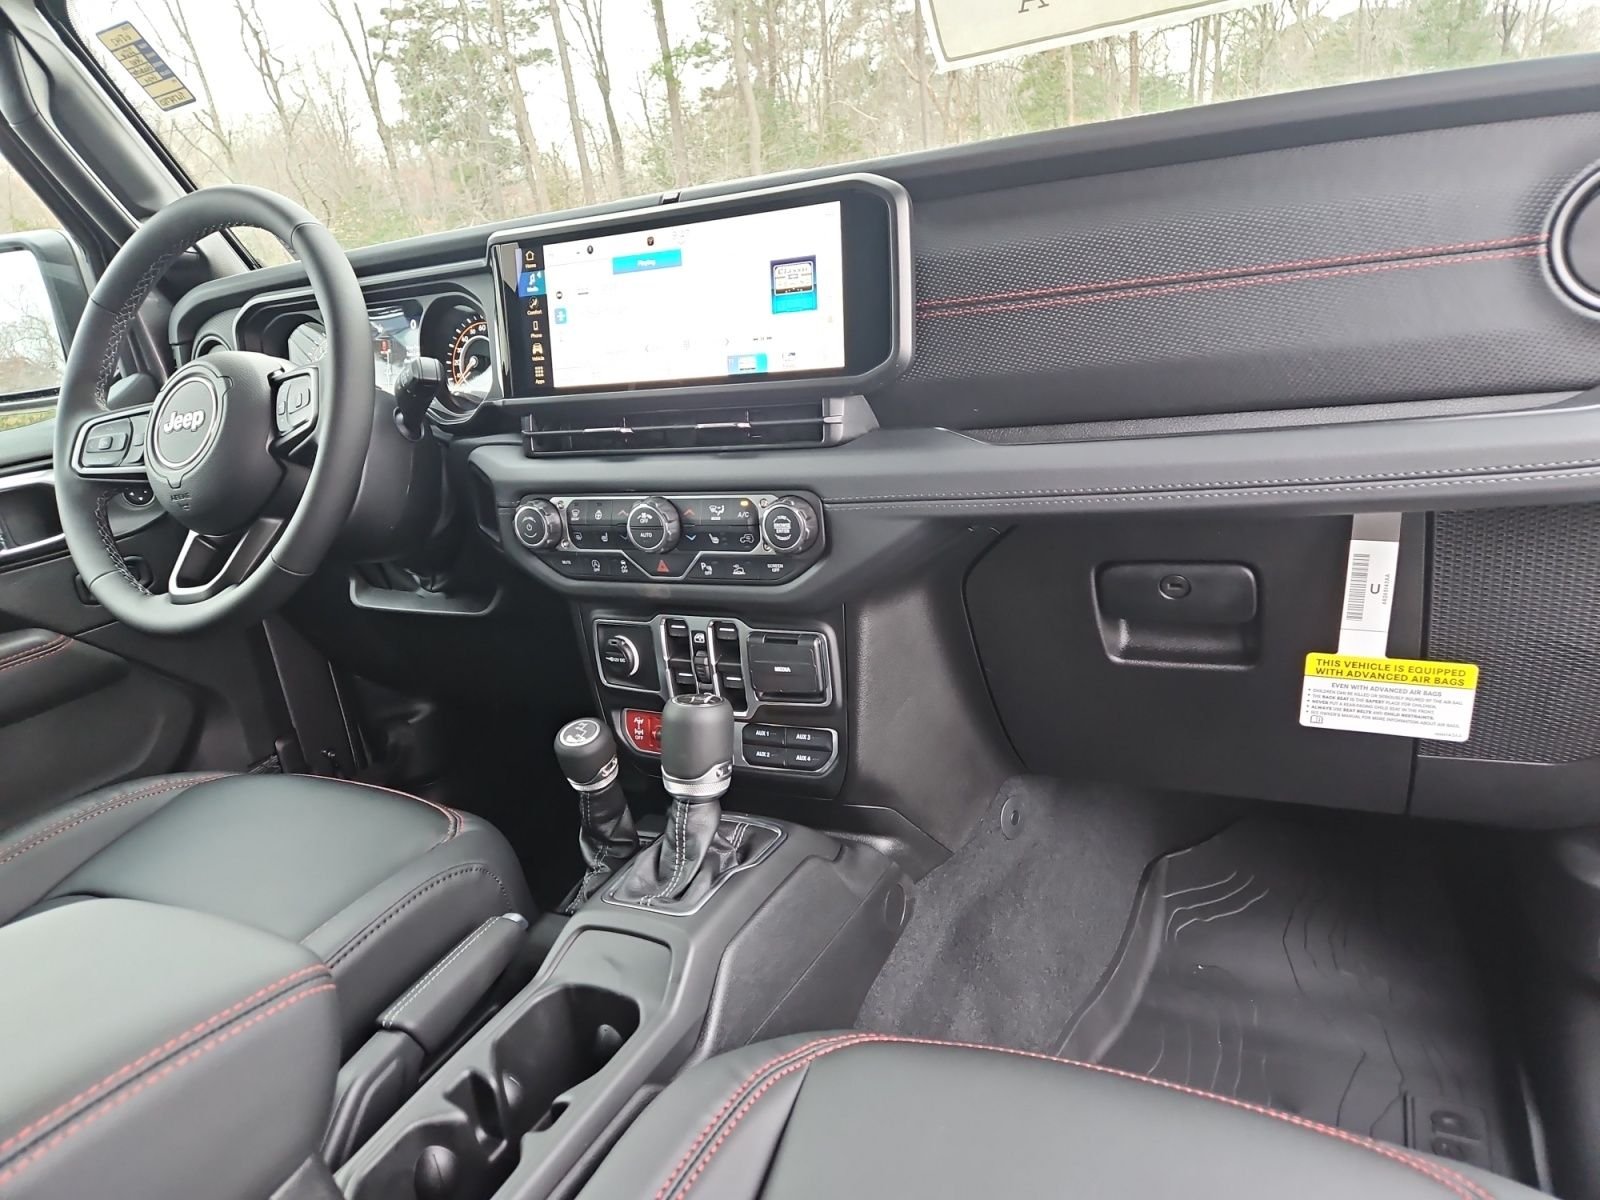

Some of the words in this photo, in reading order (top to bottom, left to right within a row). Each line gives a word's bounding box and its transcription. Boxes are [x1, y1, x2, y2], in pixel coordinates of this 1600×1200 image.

[410, 319, 417, 330] 0
[164, 409, 205, 434] Jeep
[1370, 584, 1380, 594] U
[1316, 659, 1341, 667] THIS
[1344, 661, 1390, 671] VEHICLE
[1408, 666, 1466, 677] EQUIPPED
[1316, 668, 1343, 676] WITH
[1346, 670, 1408, 681] ADVANCED
[1434, 677, 1465, 686] BAGS
